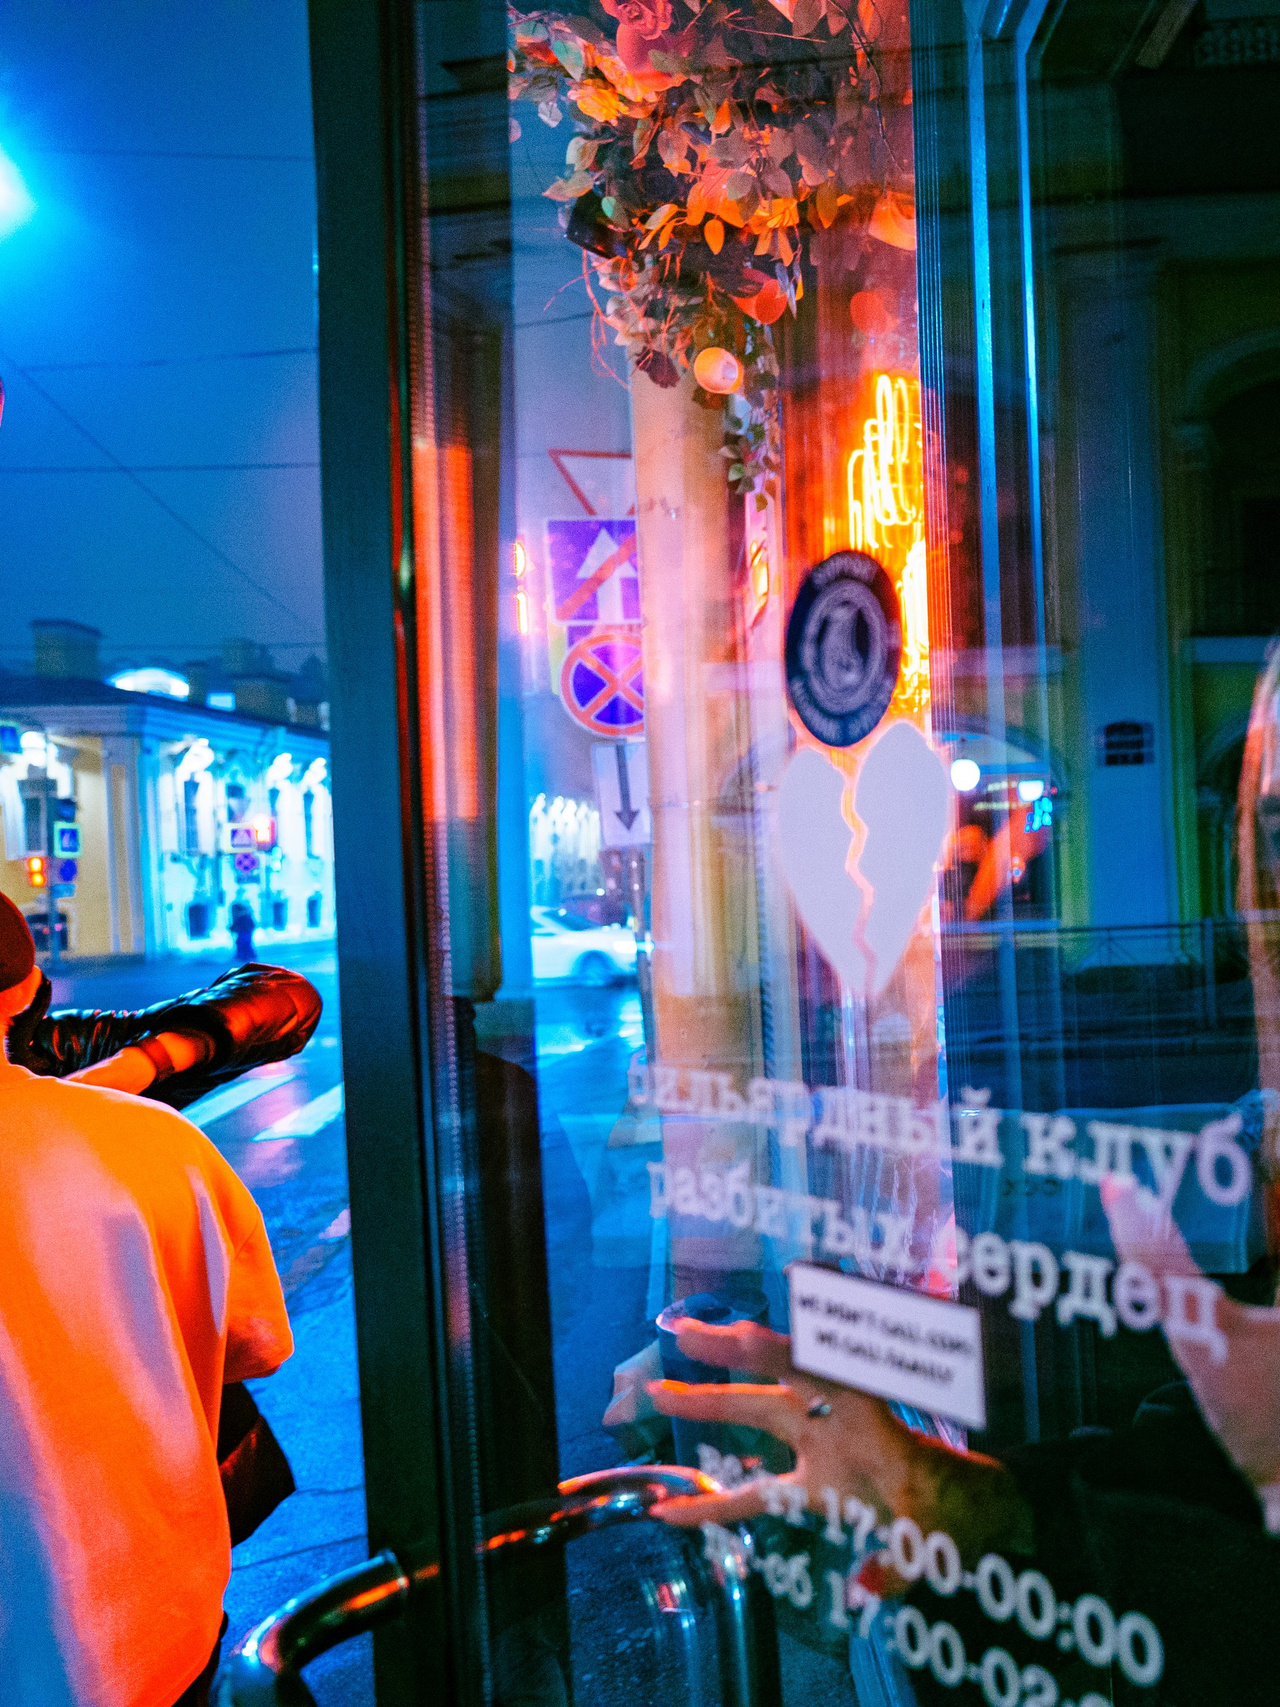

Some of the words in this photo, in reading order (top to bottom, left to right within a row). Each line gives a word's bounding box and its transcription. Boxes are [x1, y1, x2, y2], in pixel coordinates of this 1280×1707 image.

[1021, 1111, 1253, 1208] клуб
[932, 1224, 1229, 1366] сердец
[821, 1486, 1165, 1687] 17:00-00:00
